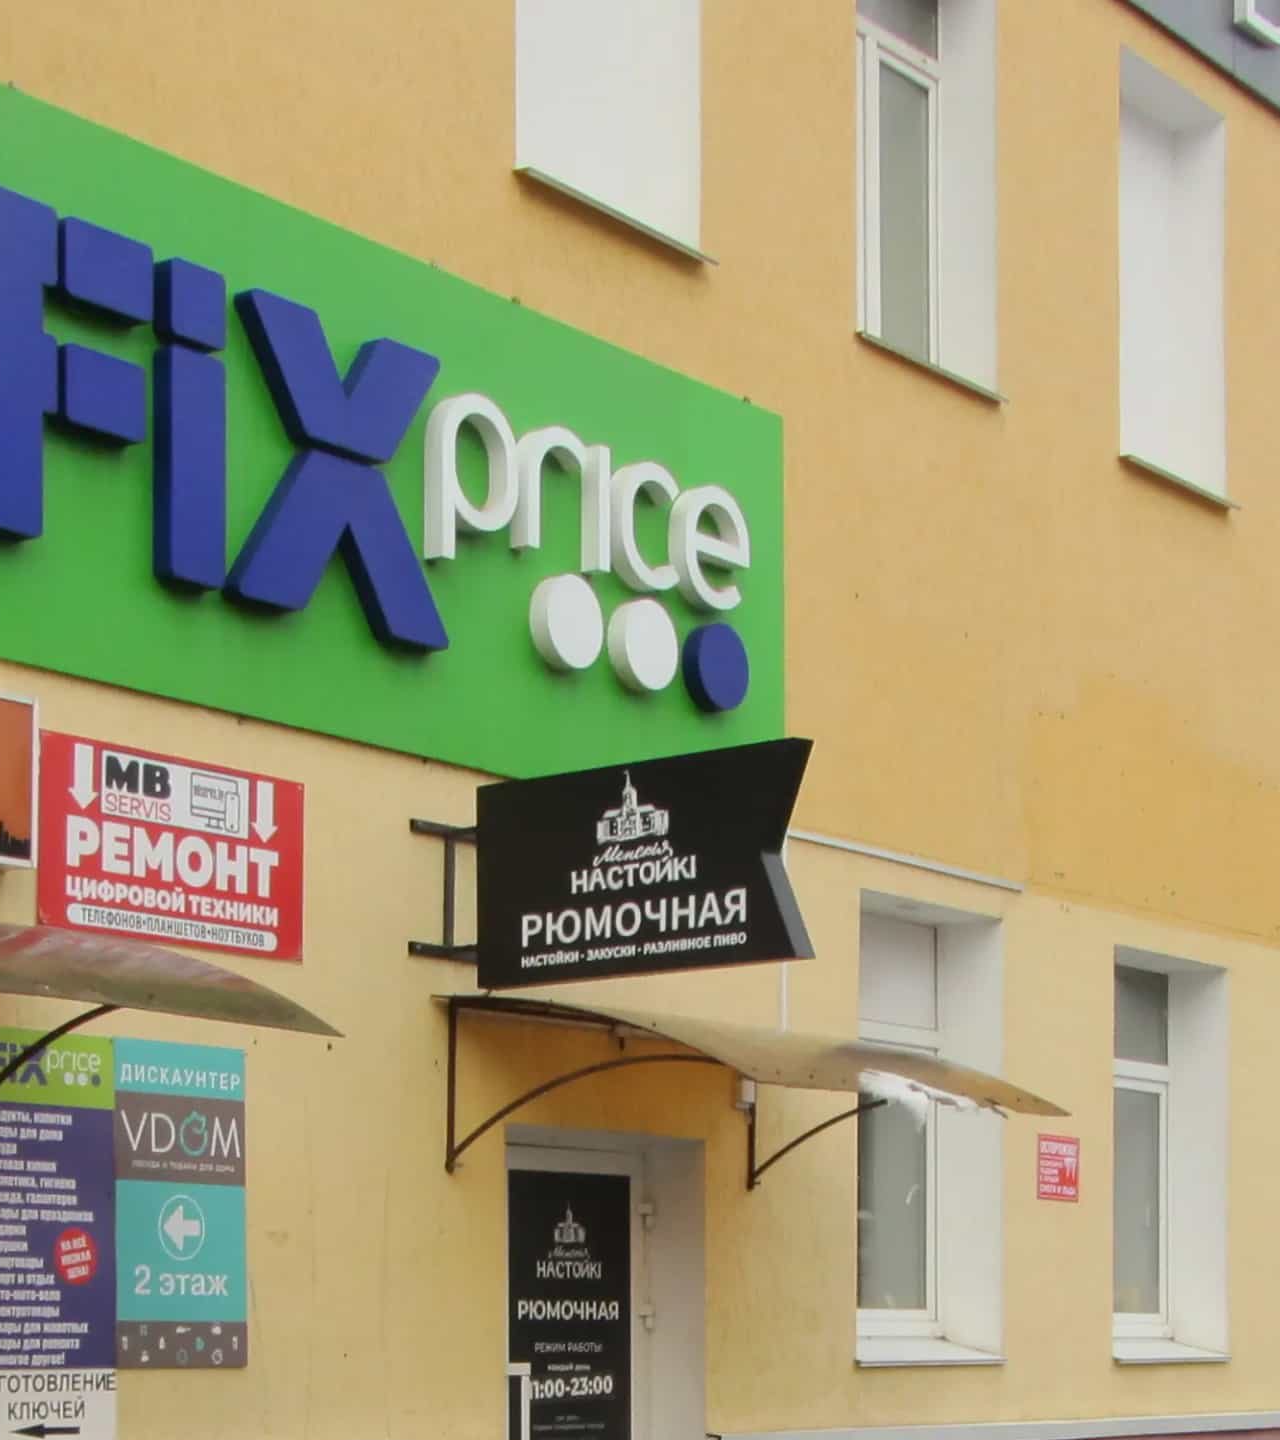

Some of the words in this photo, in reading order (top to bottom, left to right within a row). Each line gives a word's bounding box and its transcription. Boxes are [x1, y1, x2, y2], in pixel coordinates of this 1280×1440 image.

[424, 392, 751, 611] price
[105, 791, 172, 822] SERVIS
[66, 814, 279, 898] РЕМОНТ
[66, 875, 185, 914] ЦИФРОВОЙ
[188, 894, 279, 927] ТЕХНИКИ
[521, 887, 747, 948] РЮМОЧНАЯ
[521, 950, 580, 968] НАСТОЙКИ
[587, 945, 636, 961] ЗАКУСКИ
[644, 935, 711, 955] РАЗЛИВНОЕ
[713, 932, 747, 948] ПИВО
[46, 1049, 102, 1073] price
[119, 1063, 241, 1091] ДИСКАУНТЕР
[120, 1108, 241, 1159] VDOM
[134, 1263, 152, 1296] 2
[159, 1272, 230, 1297] этаж
[517, 1299, 620, 1321] РЮМОЧНАЯ
[534, 1341, 567, 1353] РЕЖИМ
[7, 1394, 86, 1420] КЛЮЧЕЙ
